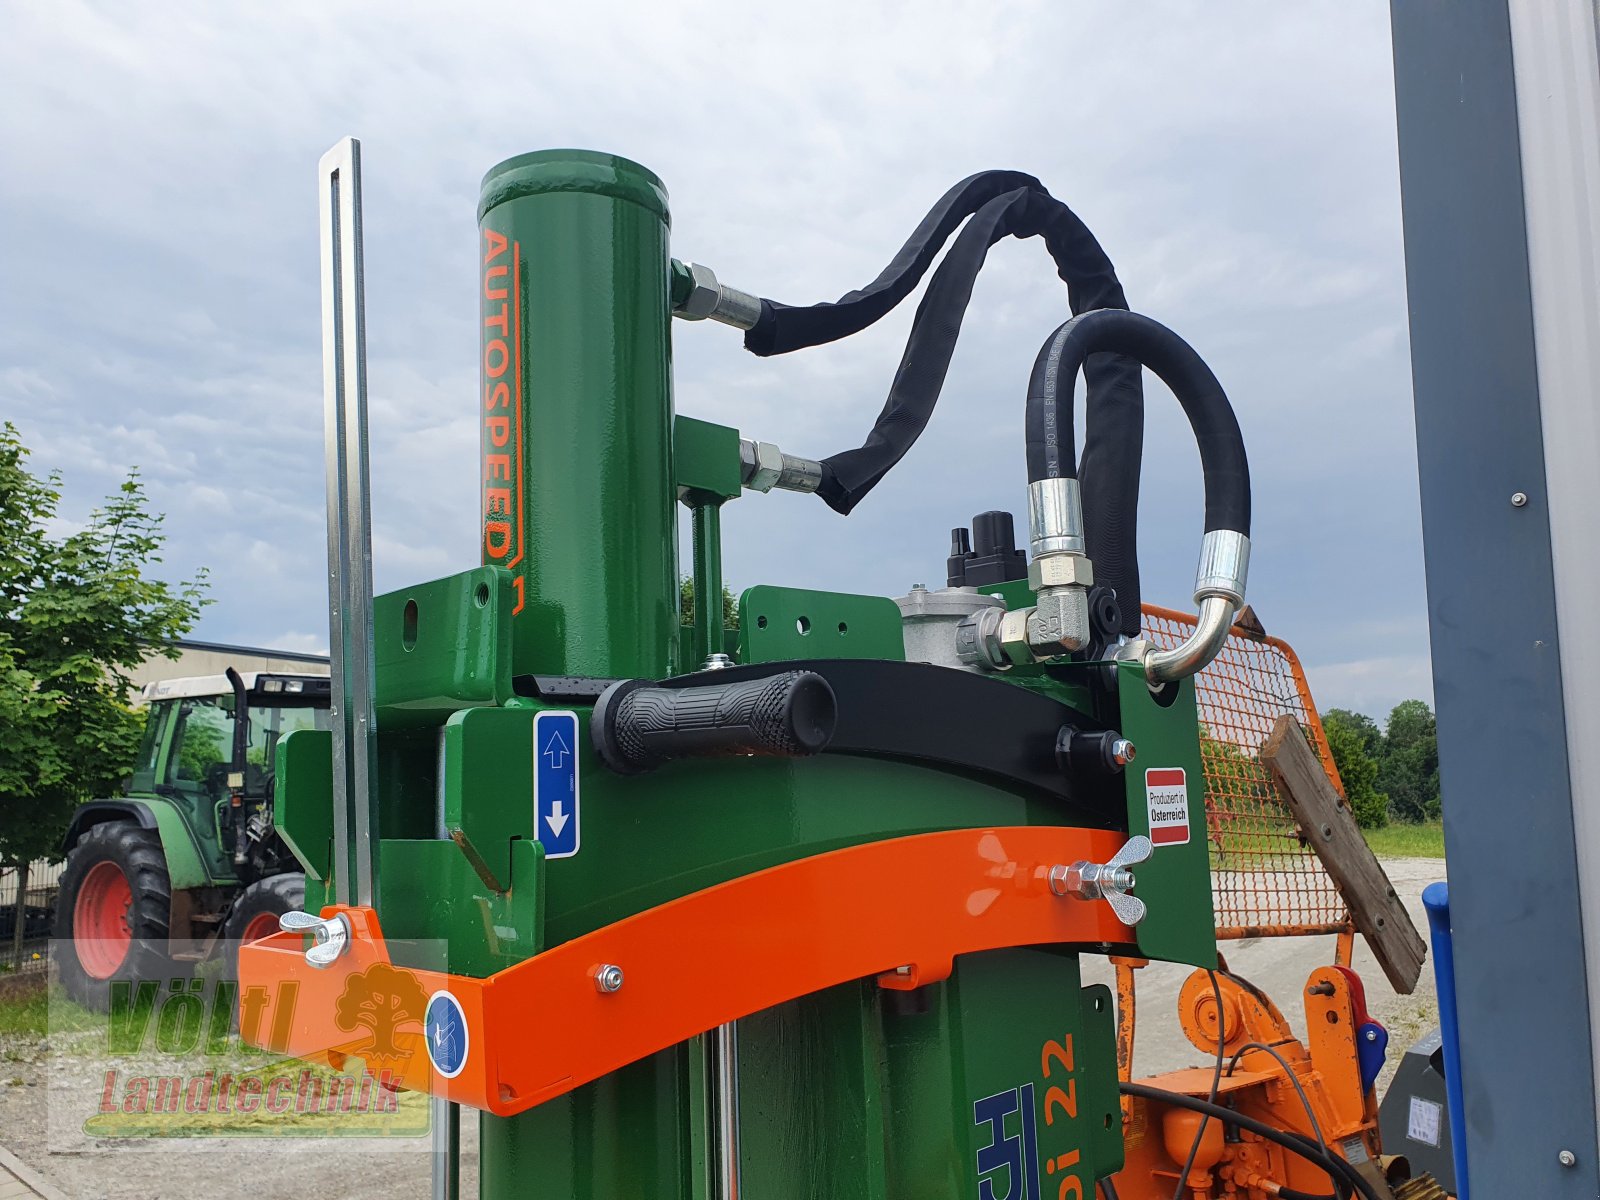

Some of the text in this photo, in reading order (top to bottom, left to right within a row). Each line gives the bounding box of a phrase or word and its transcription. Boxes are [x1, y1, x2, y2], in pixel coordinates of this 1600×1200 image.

[483, 227, 511, 559] AUTOSPEED
[1045, 395, 1055, 406] EN
[1045, 412, 1056, 430] 1436
[1046, 434, 1056, 448] ISO
[1149, 790, 1185, 805] Produziert in
[1041, 1033, 1078, 1126] 22
